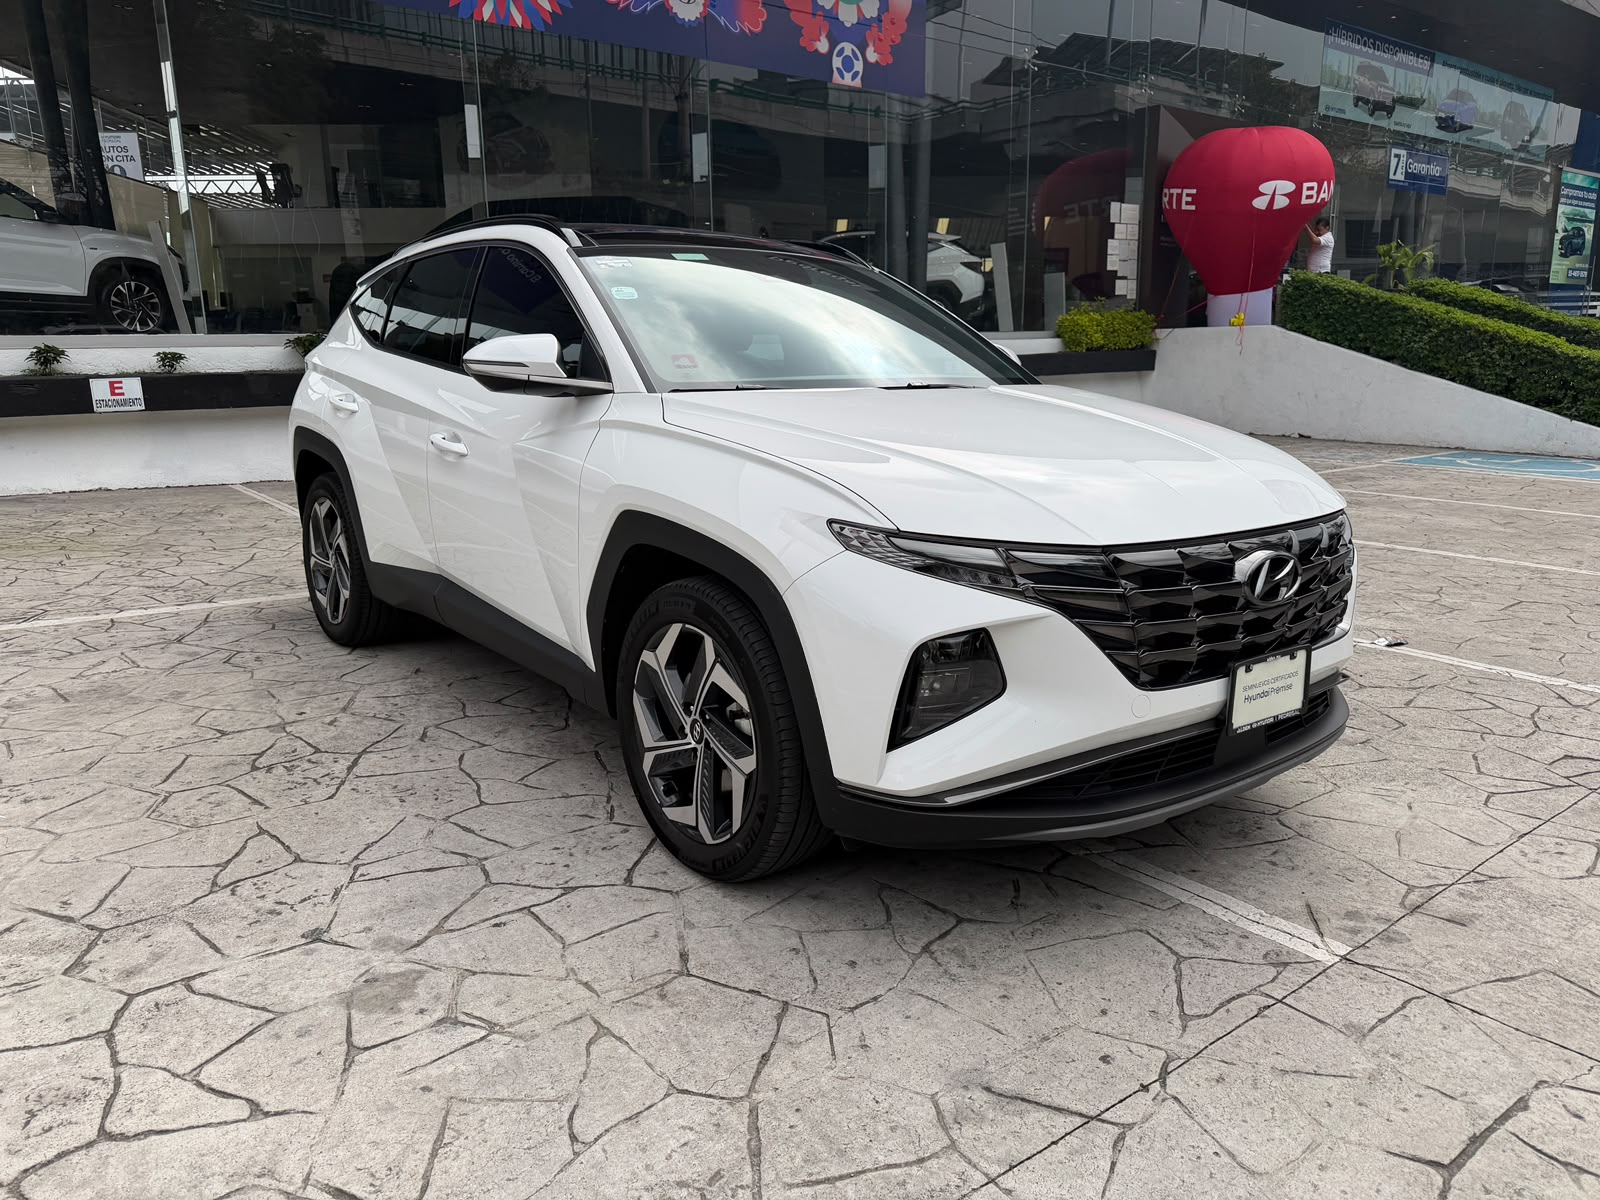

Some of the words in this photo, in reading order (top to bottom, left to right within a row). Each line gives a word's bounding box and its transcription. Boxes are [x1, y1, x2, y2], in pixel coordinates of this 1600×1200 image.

[1328, 25, 1374, 54] ¡HÍBRIDOS
[1375, 41, 1431, 70] DISPONIBLES!
[115, 154, 137, 163] CITA
[1393, 153, 1401, 177] 7
[1406, 158, 1440, 177] Garantía
[1162, 188, 1197, 211] RTE
[1561, 186, 1583, 197] Compramos
[108, 380, 125, 396] E
[95, 397, 143, 409] ESTACIONAMIENTO
[1242, 680, 1270, 693] SEMINUEVOS
[1270, 670, 1299, 685] CERTIFICADOS
[1243, 687, 1270, 704] Hyundai
